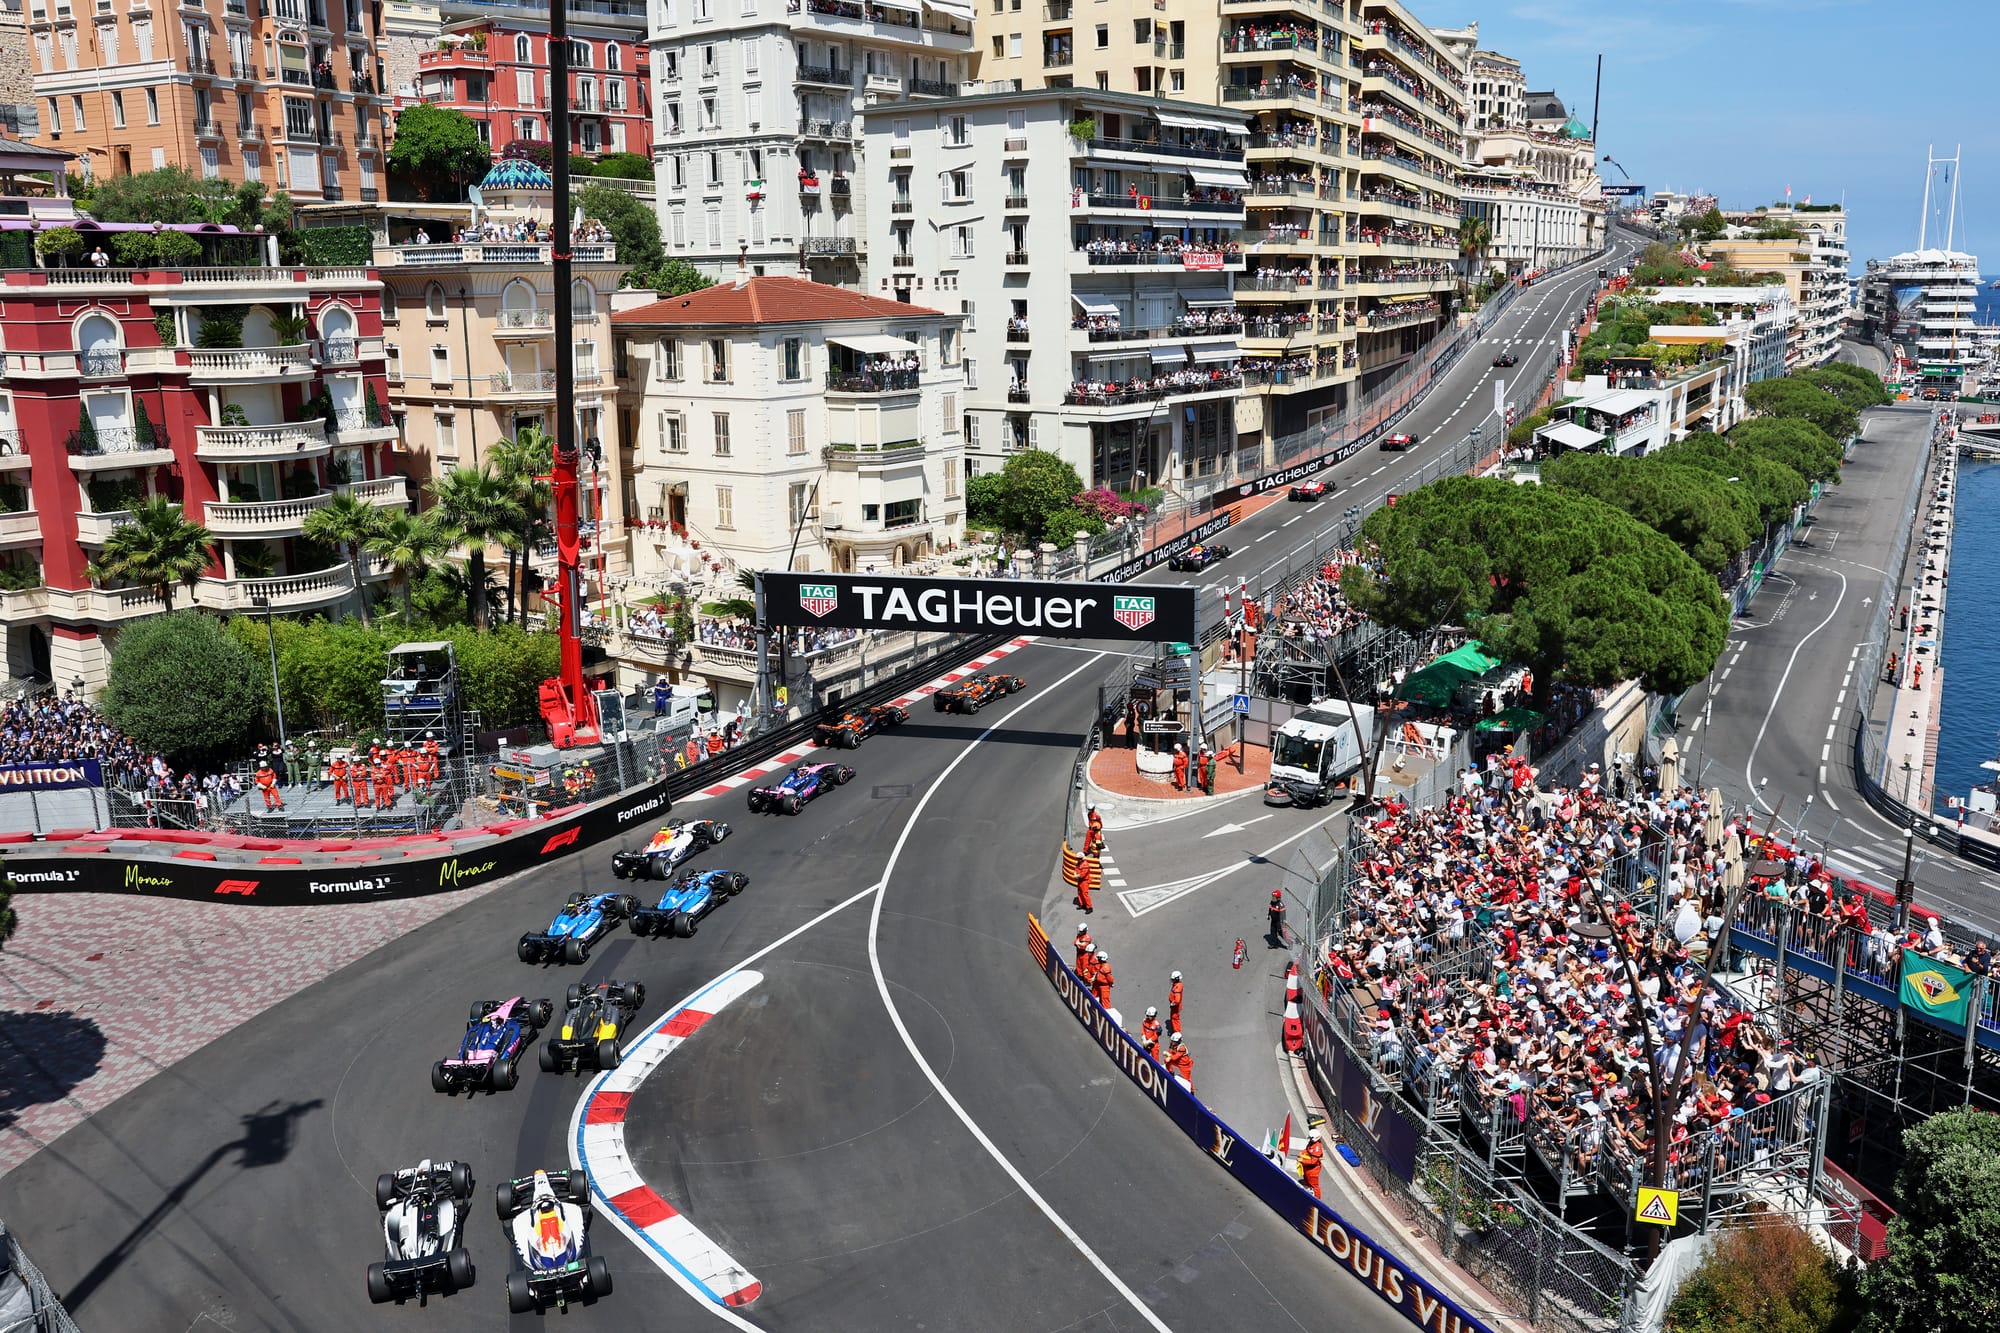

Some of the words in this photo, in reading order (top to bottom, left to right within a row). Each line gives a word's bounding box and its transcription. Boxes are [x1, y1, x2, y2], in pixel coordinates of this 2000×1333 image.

[802, 586, 834, 598] TAG
[802, 599, 836, 615] HEUER
[1116, 598, 1152, 610] TAG
[1116, 611, 1153, 628] HEUER
[0, 766, 86, 786] VUITTON
[617, 798, 659, 823] Formula
[7, 870, 64, 883] Formula
[439, 858, 497, 888] Monaco
[309, 878, 374, 894] Formula
[1054, 959, 1091, 1026] LOUIS
[1095, 1008, 1168, 1108] VUITTON
[1311, 1206, 1405, 1304] LOUIS
[1415, 1284, 1476, 1333] VU
